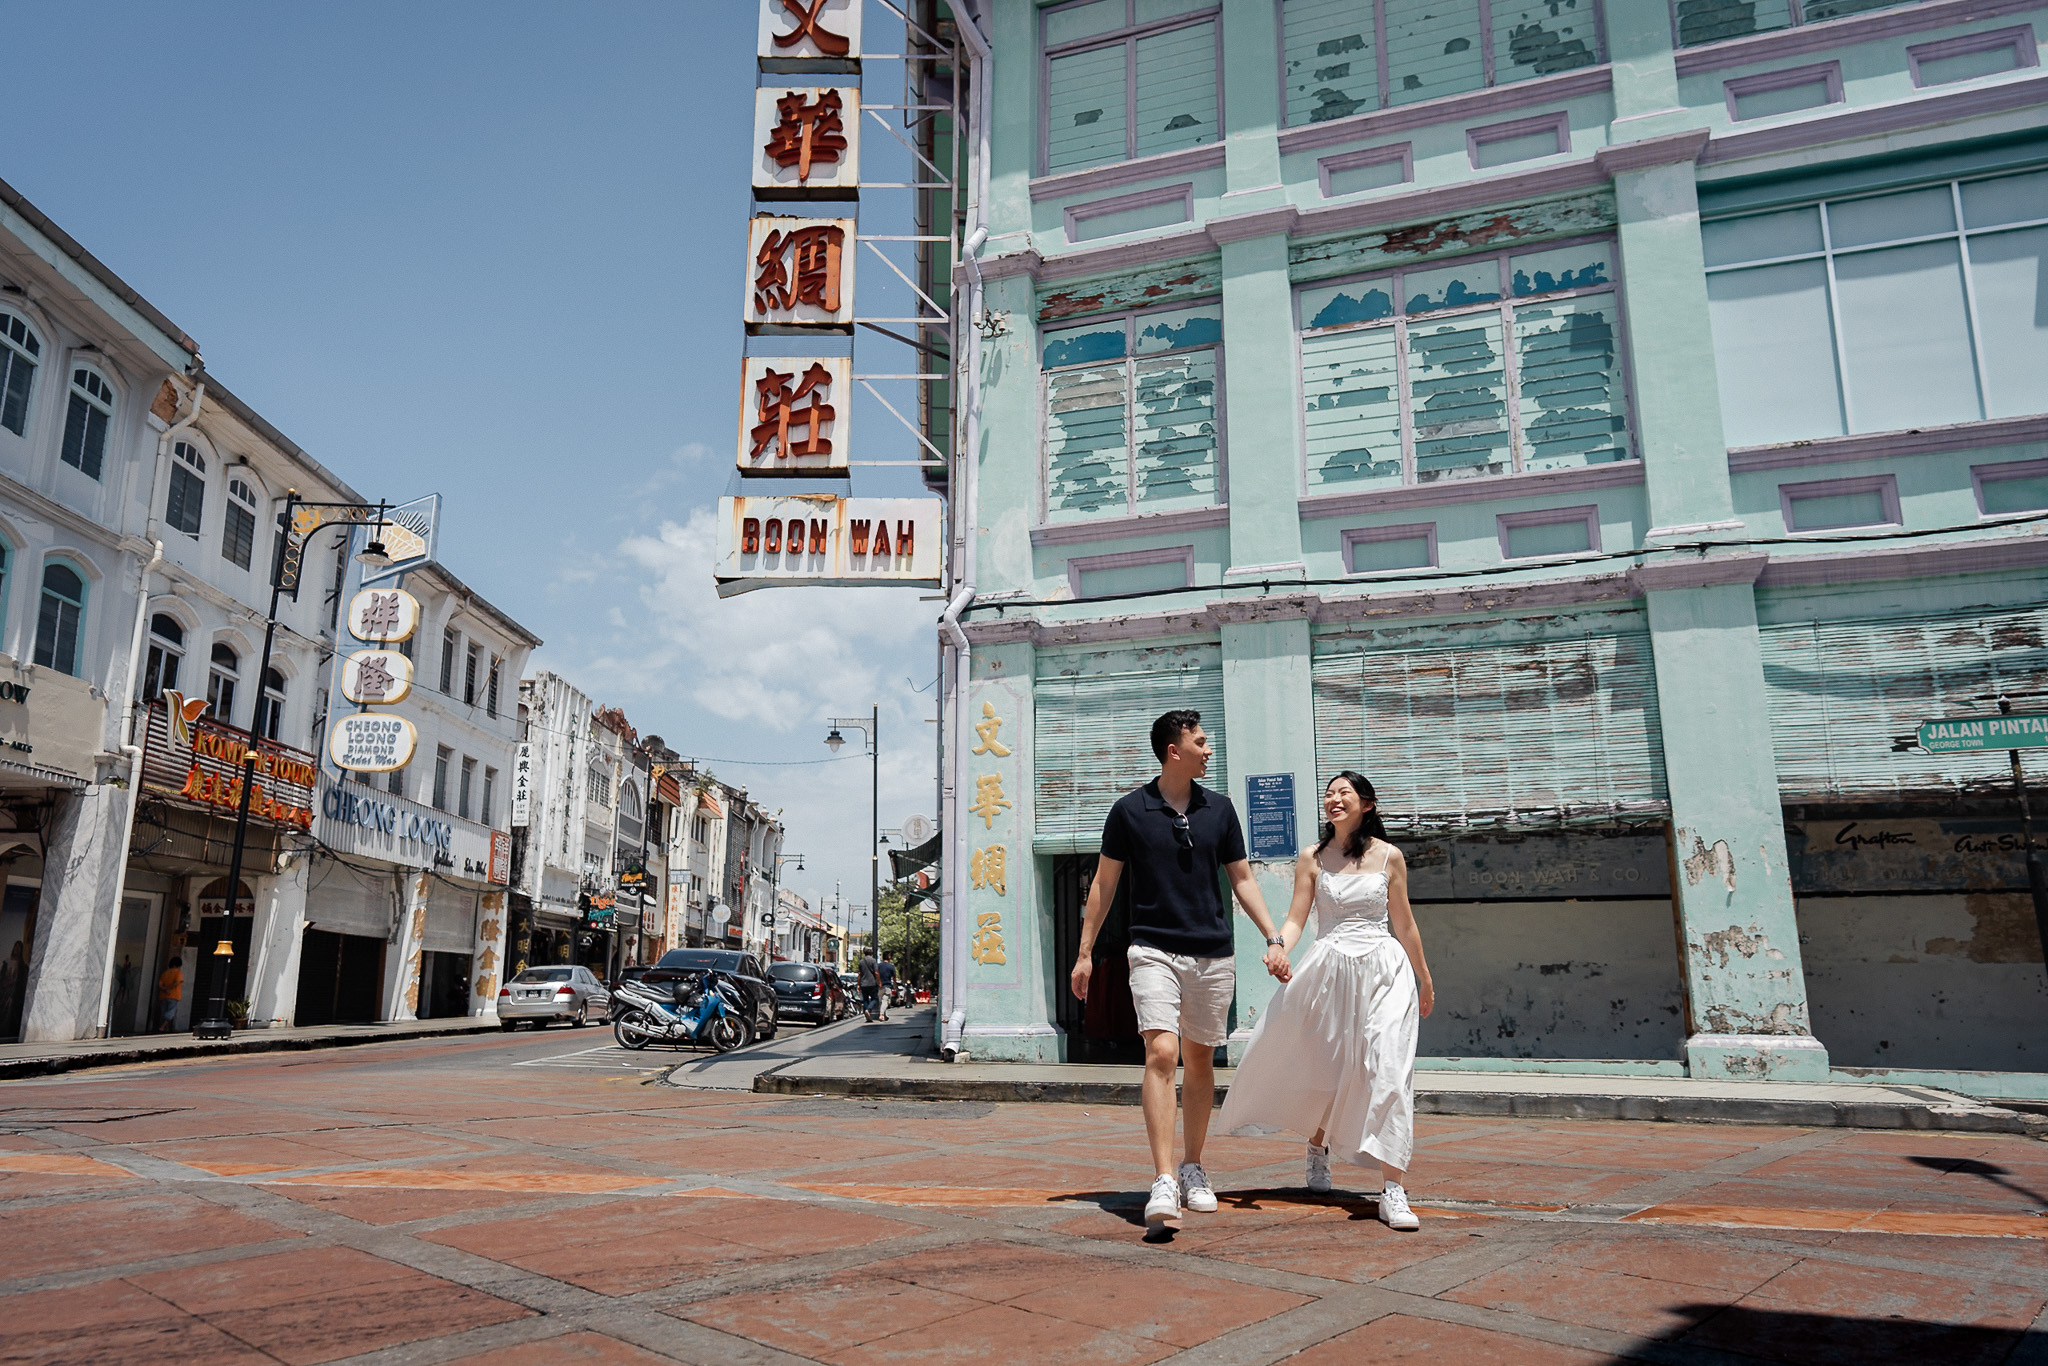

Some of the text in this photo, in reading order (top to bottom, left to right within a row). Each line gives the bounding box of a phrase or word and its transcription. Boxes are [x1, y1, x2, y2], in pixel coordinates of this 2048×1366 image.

[742, 517, 914, 556] BOON WAH
[354, 592, 399, 696] 祥隆
[345, 720, 402, 734] CHEONG
[1927, 721, 1984, 739] JALAN
[348, 732, 397, 745] LOONG
[1929, 740, 1961, 749] GEORGE
[1962, 739, 1984, 748] TOWN
[193, 729, 316, 786] KOMTR TOURS
[347, 744, 395, 755] DIAMOND
[375, 754, 397, 767] Mas
[323, 787, 396, 835] CHEONG
[399, 810, 451, 850] LOONG
[1835, 822, 1917, 850] Grafton
[1469, 872, 1520, 884] BOON
[1532, 869, 1578, 883] WAH
[1591, 869, 1600, 881] &
